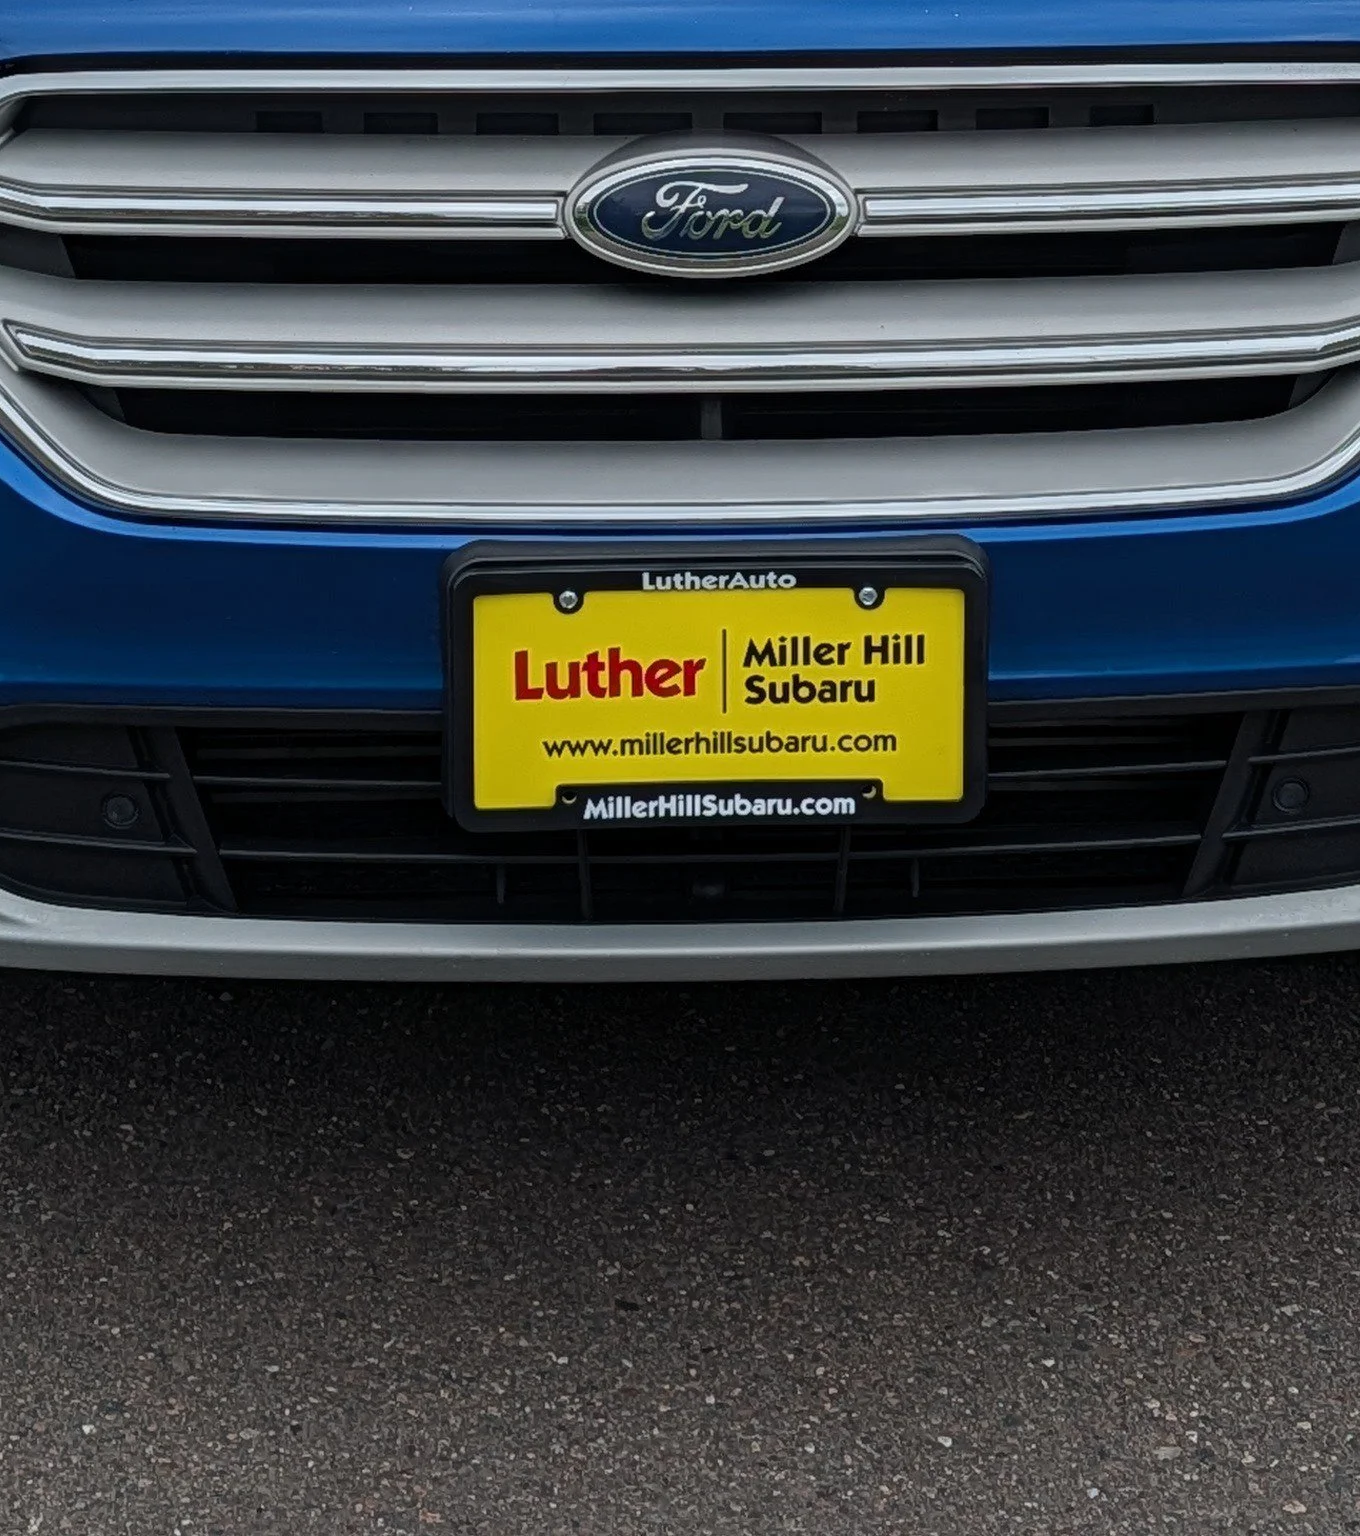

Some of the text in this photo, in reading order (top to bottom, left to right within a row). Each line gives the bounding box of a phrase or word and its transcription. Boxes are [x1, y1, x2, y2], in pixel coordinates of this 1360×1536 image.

[641, 180, 785, 241] Ford
[641, 571, 797, 591] LutherAuto
[742, 634, 926, 667] Miller Hill
[514, 646, 707, 702] Luther
[743, 674, 876, 704] Subaru
[542, 731, 897, 758] www.millerhillsubaru.com
[583, 793, 856, 821] MillerHillSubaru.com
